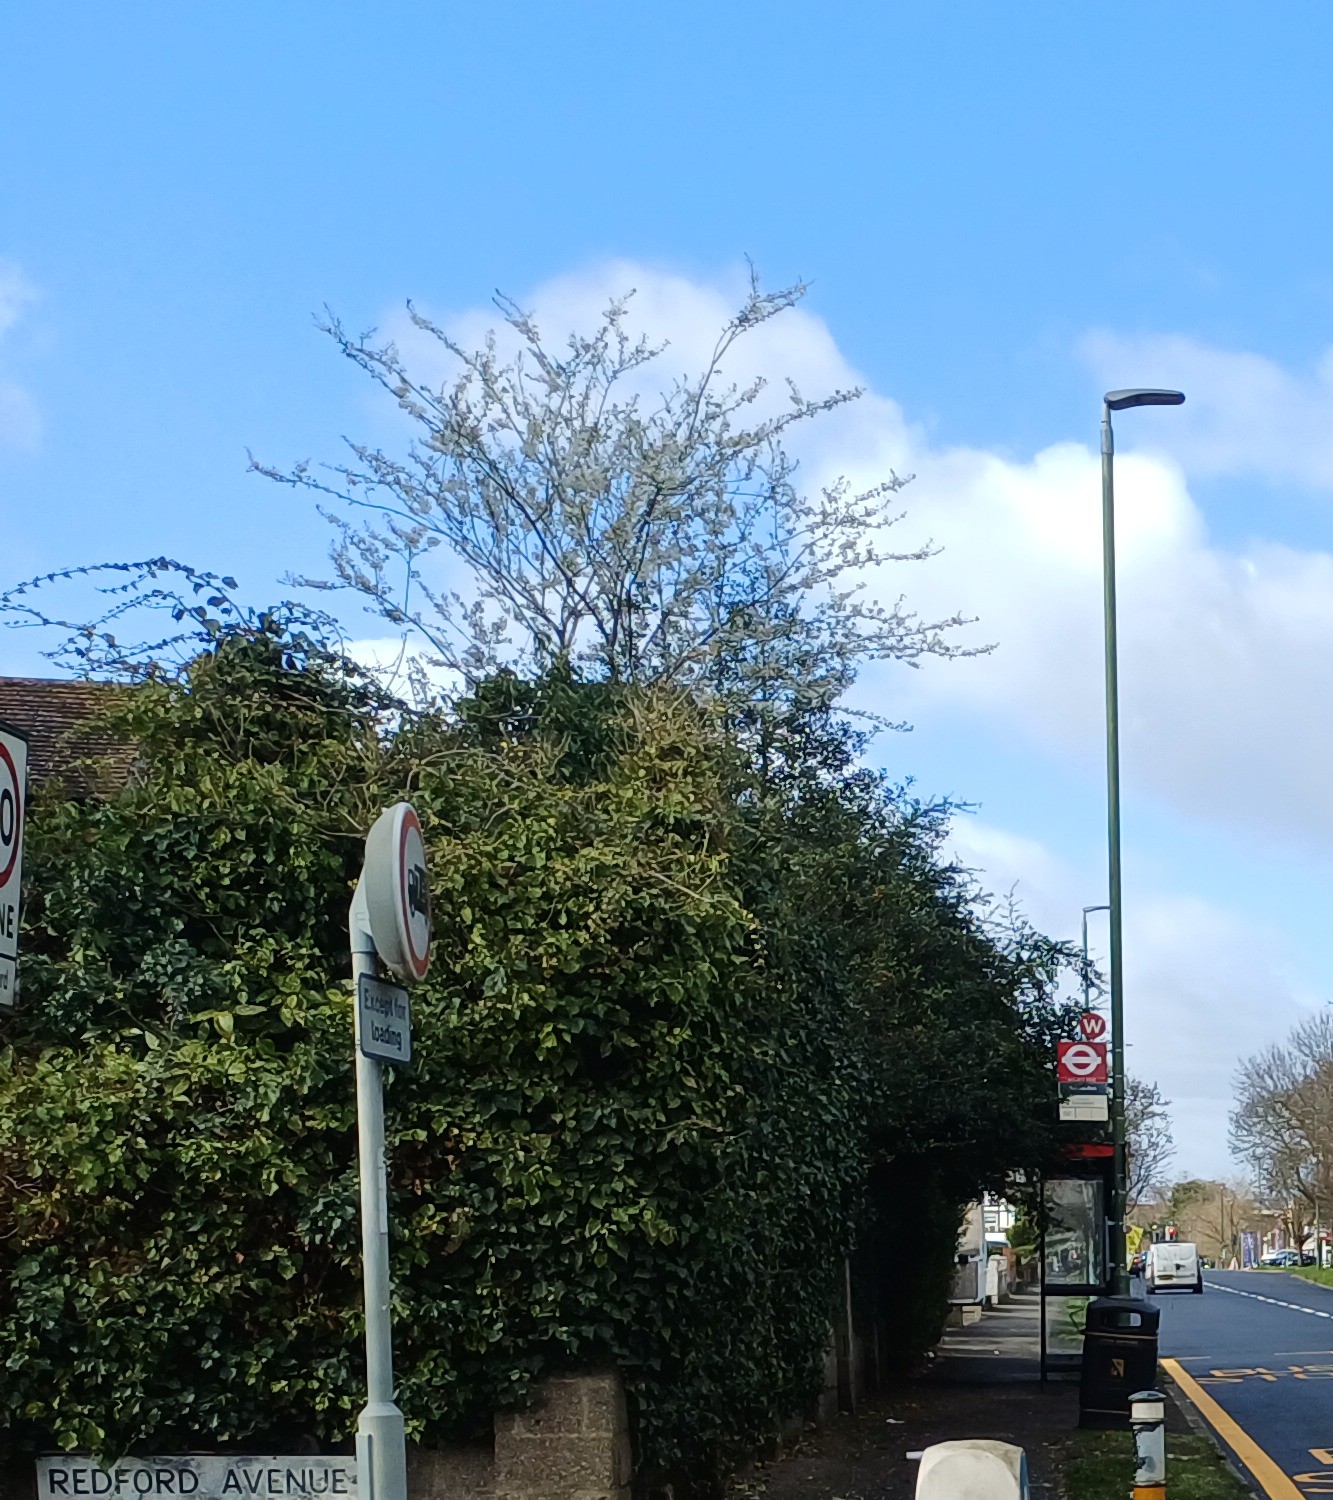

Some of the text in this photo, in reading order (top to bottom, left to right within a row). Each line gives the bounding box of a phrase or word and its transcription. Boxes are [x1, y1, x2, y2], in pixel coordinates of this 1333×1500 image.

[0, 788, 13, 846] 0
[364, 987, 393, 1018] Except
[371, 1019, 402, 1052] loading
[1083, 1018, 1102, 1034] W
[49, 1468, 348, 1495] REDFORD AVENUE
